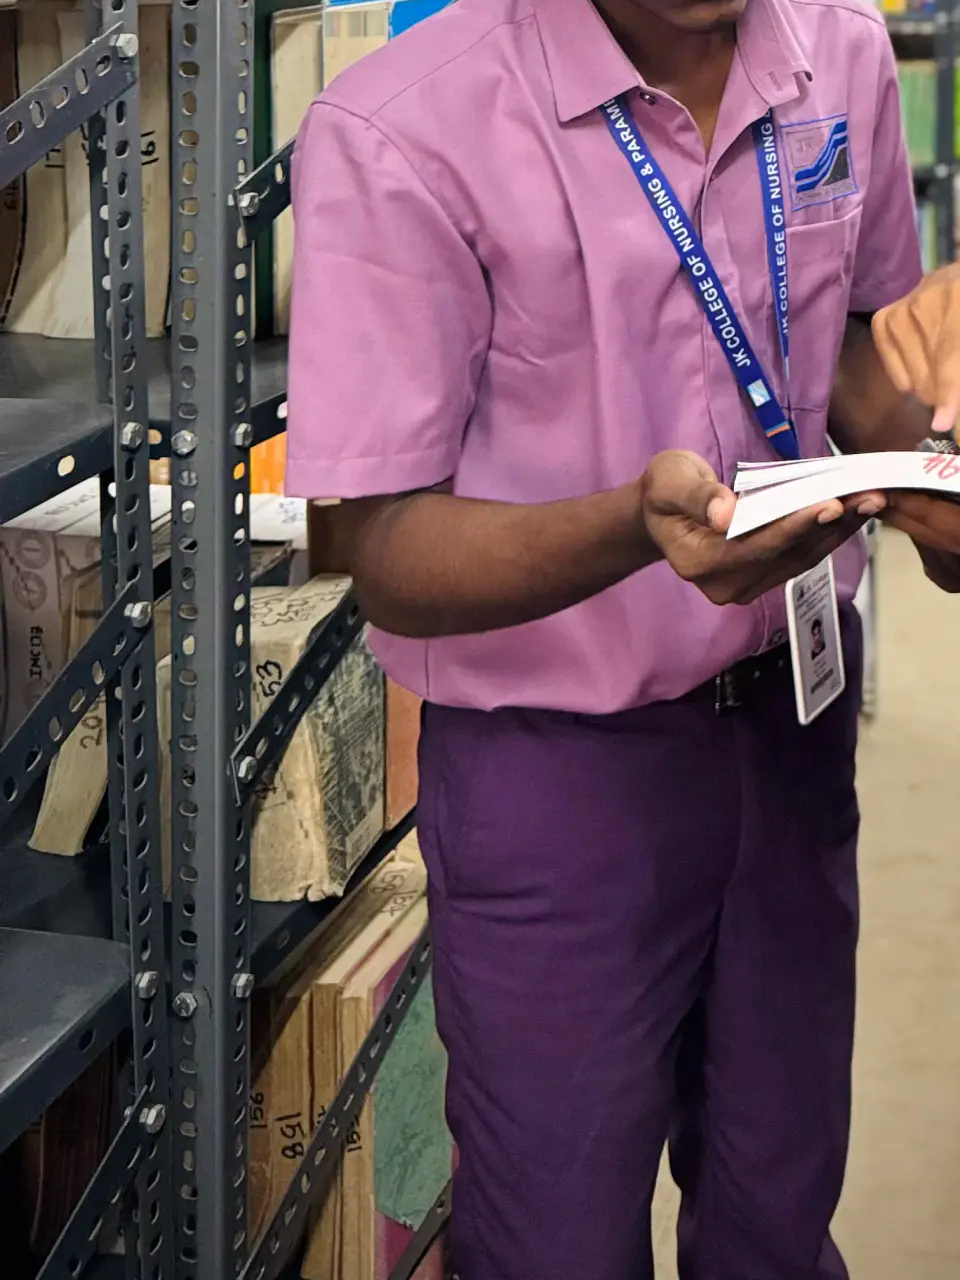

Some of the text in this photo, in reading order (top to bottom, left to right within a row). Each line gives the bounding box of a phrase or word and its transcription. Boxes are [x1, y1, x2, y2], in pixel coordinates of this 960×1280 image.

[640, 163, 654, 177] &
[761, 121, 781, 200] NURSING
[648, 178, 695, 253] NURSING
[772, 206, 784, 228] OF
[687, 255, 706, 278] OF
[774, 230, 789, 314] COLLEGE
[699, 277, 741, 350] COLLEGE
[732, 348, 751, 368] JK
